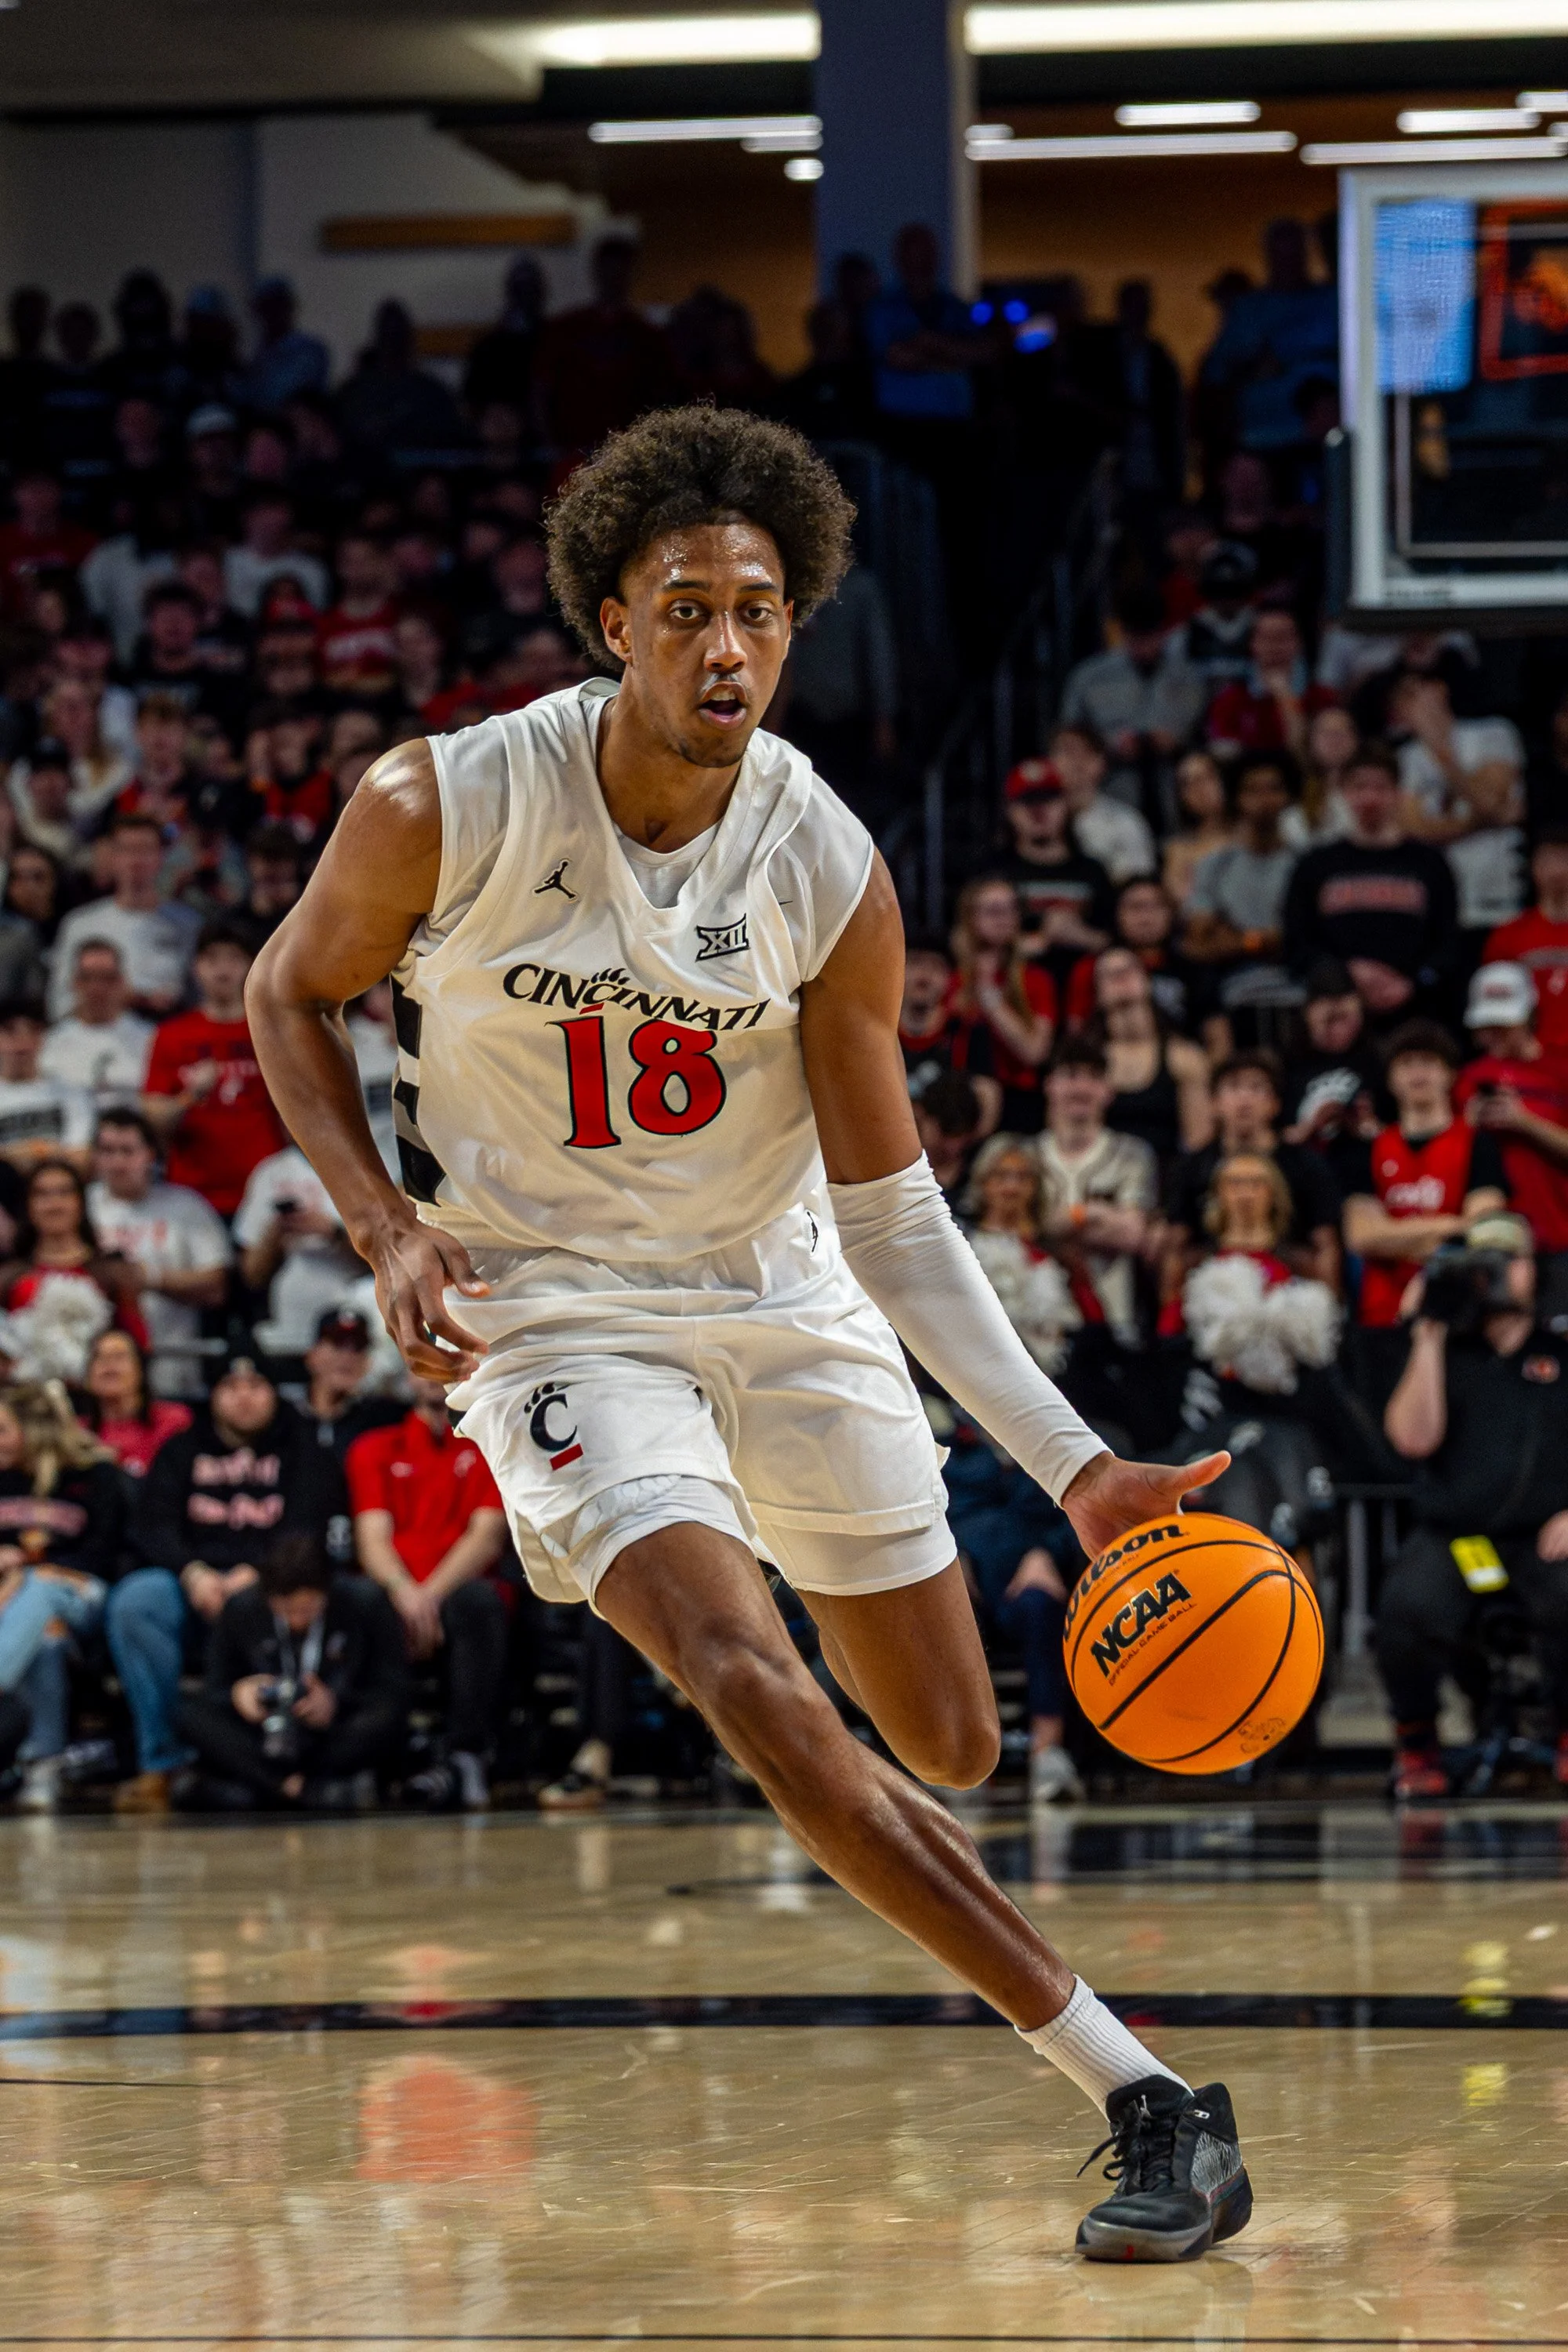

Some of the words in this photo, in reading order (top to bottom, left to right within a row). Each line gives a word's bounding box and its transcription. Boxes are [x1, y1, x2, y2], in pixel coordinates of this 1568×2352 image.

[503, 963, 771, 1031] CINCINNATI
[544, 1015, 727, 1149] 18
[1090, 1571, 1192, 1678] NCAA
[1138, 1621, 1168, 1648] GAME
[1167, 1602, 1197, 1623] BALL
